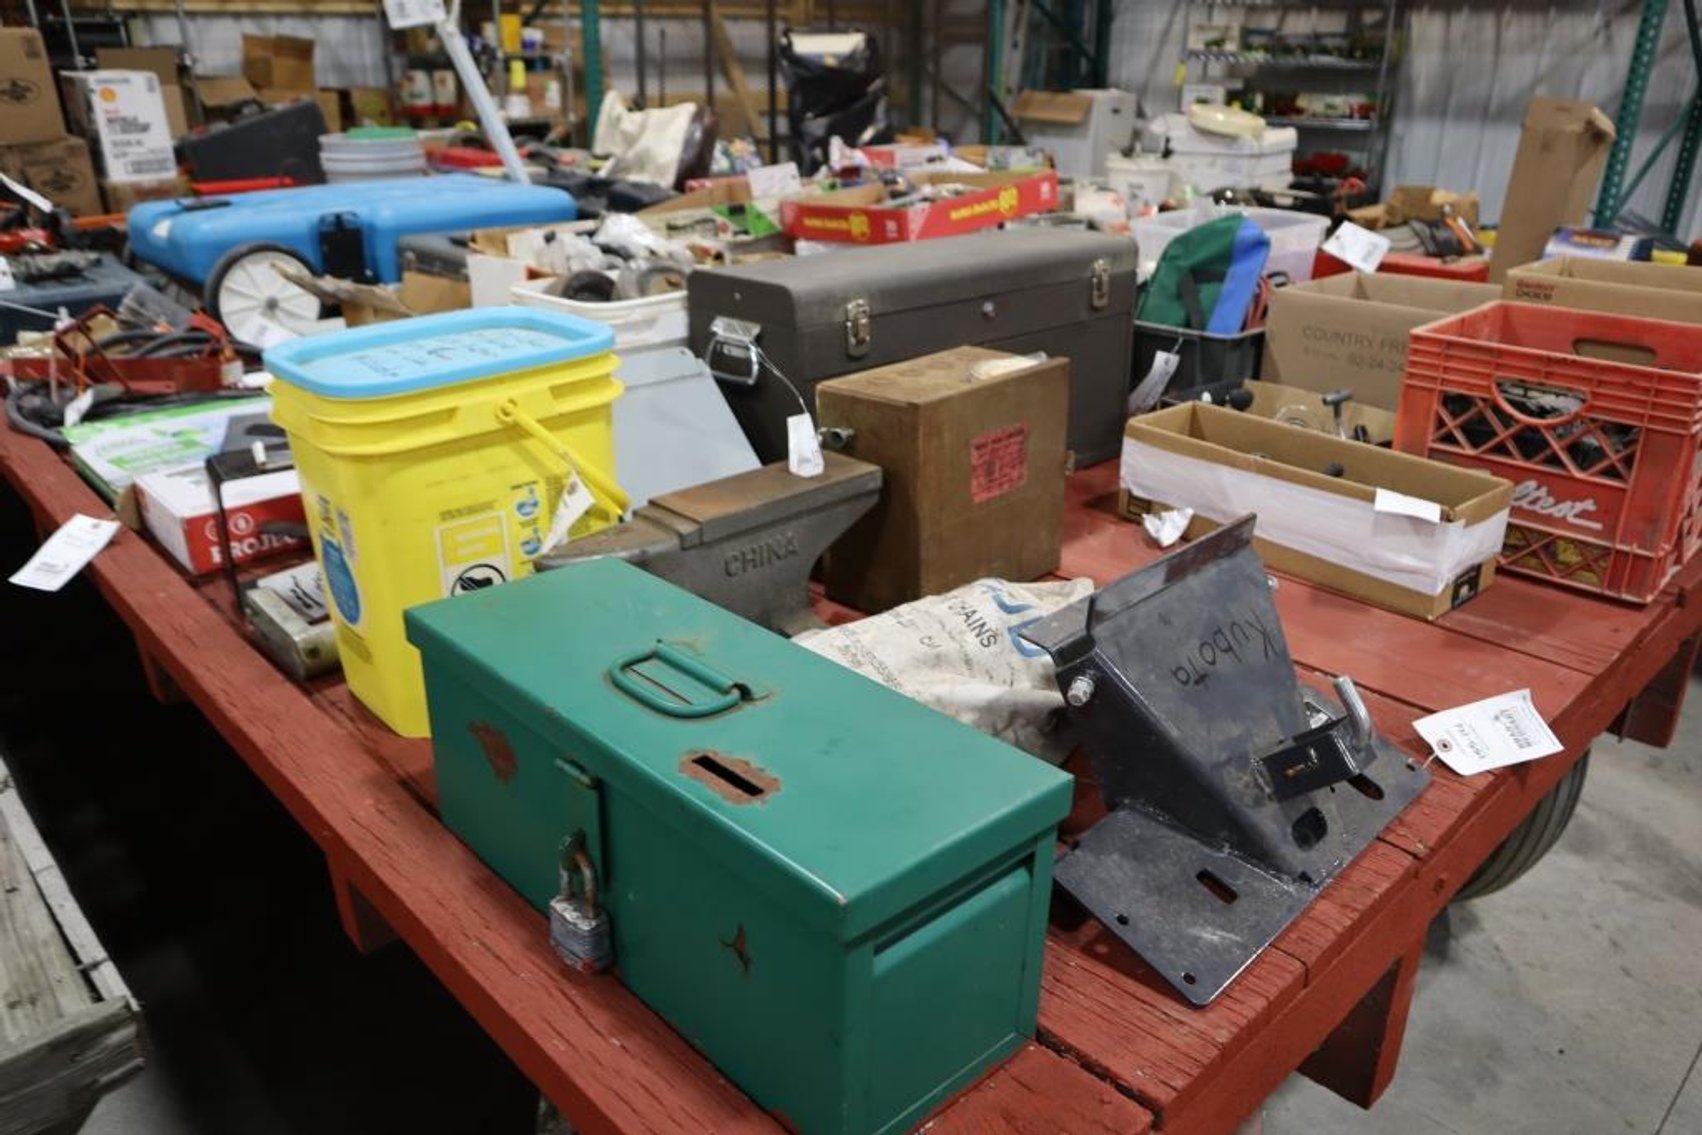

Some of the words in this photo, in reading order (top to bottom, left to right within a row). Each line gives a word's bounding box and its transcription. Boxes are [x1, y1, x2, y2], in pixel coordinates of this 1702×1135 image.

[1302, 325, 1373, 349] COUNTRY
[1510, 479, 1603, 531] ltest
[723, 533, 800, 578] CHINA
